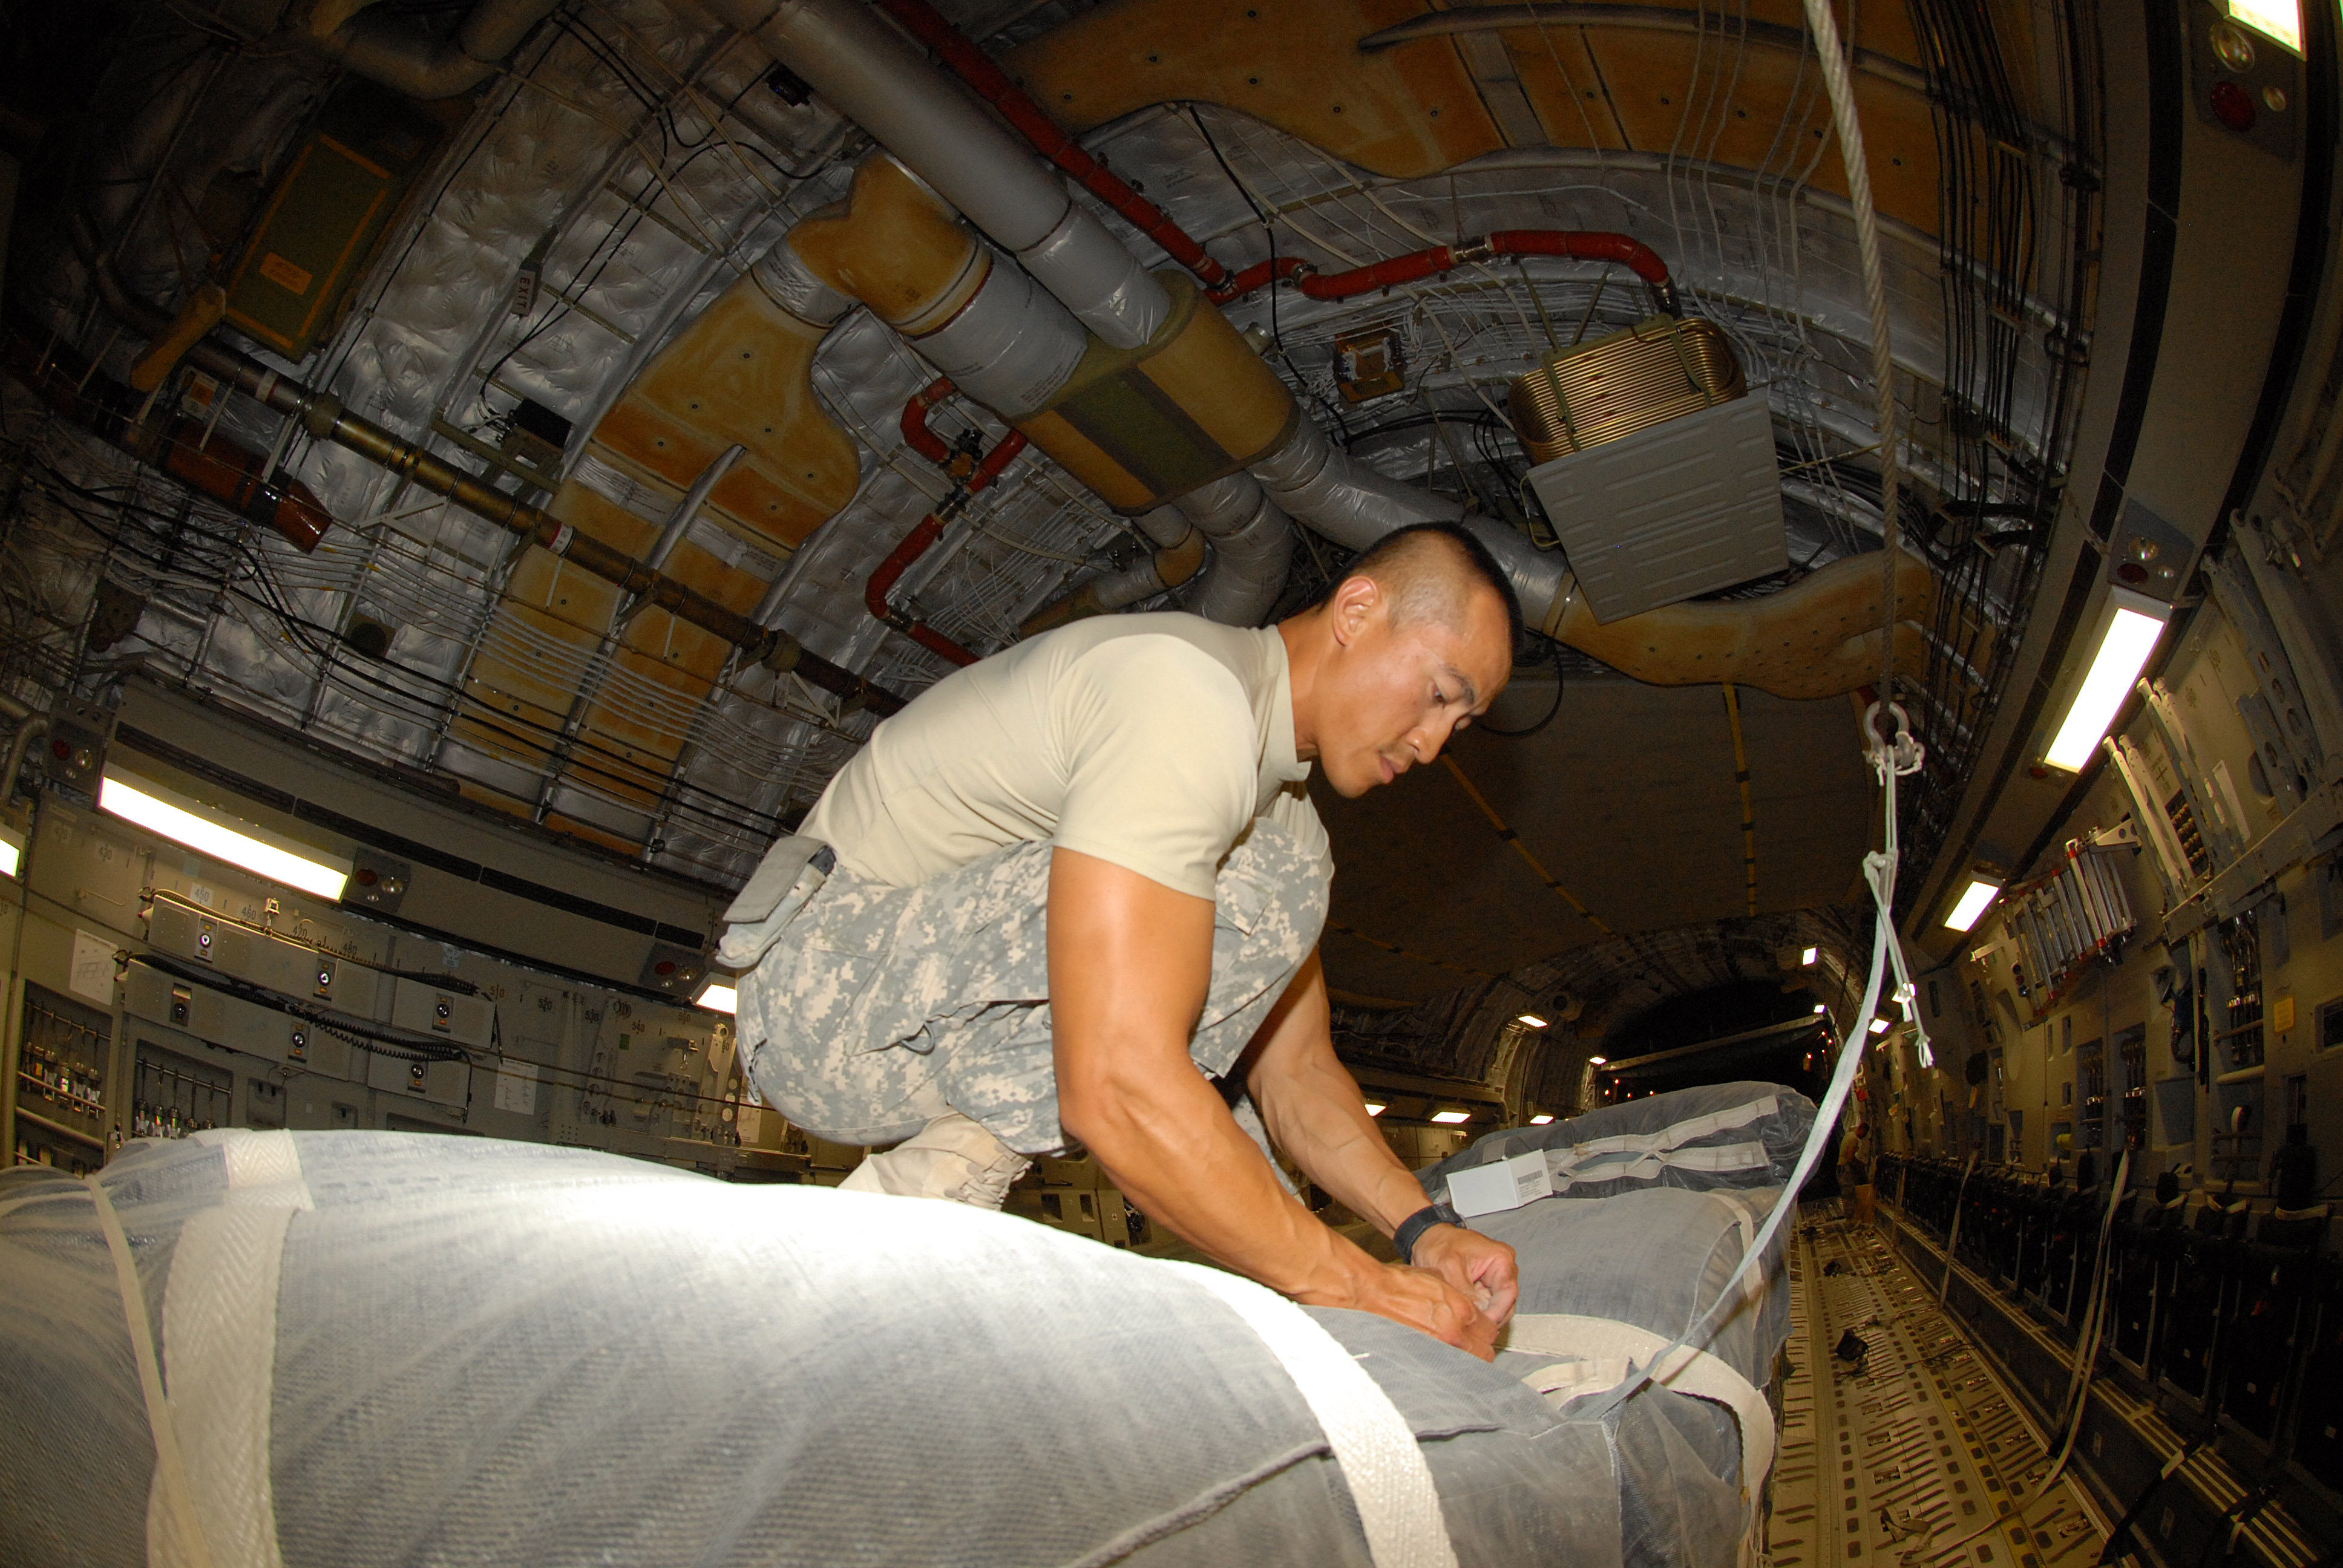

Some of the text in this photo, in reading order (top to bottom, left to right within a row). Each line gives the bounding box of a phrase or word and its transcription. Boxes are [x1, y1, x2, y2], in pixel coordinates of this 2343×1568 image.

[517, 277, 531, 309] EXIT
[99, 848, 113, 860] 430
[194, 889, 209, 902] 450
[241, 909, 257, 920] 460
[342, 943, 358, 955] 480
[490, 985, 505, 998] 510
[538, 999, 552, 1010] 520
[585, 1011, 599, 1022] 530
[678, 1014, 691, 1022] 550
[632, 1023, 645, 1032] 540
